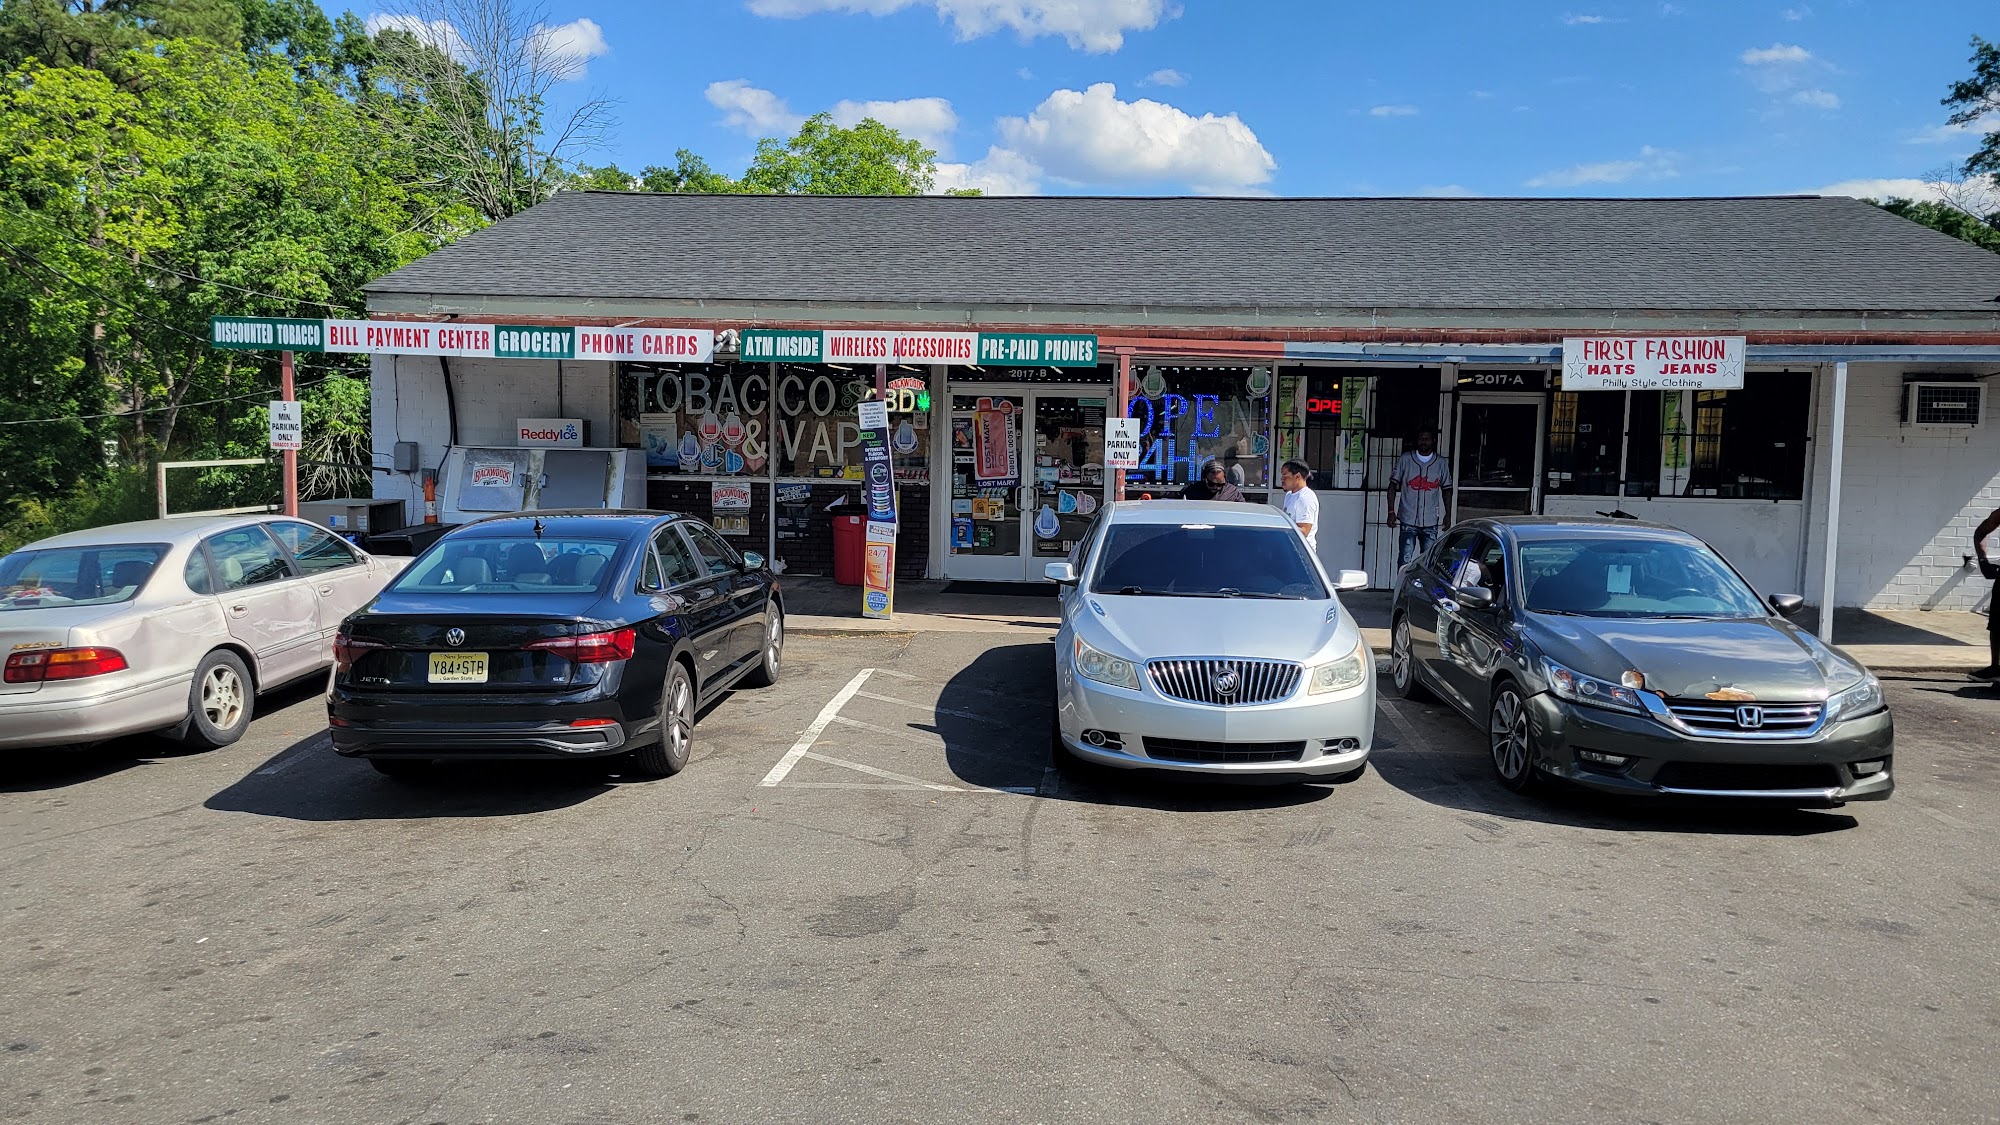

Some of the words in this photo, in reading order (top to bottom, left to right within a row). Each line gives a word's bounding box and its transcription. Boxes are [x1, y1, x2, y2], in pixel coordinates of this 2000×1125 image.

[214, 321, 273, 344] DISCOUNTED
[276, 324, 321, 346] TOBACCO
[330, 326, 359, 346] BILL
[367, 327, 430, 348] PAYMENT
[438, 329, 490, 350] CENTER
[499, 330, 570, 353] GROCERY
[581, 333, 634, 354] PHONE
[642, 334, 698, 356] CARDS
[745, 336, 773, 357] ATM
[776, 336, 819, 357] INSIDE
[830, 337, 887, 357] WIRELESS
[893, 337, 971, 359] ACCESSORIES
[982, 339, 1039, 361] PRE-PAID
[1044, 340, 1093, 362] PHONES
[1583, 340, 1638, 361] FIRST
[1645, 339, 1725, 361] FASHION
[1587, 364, 1636, 375] HATS
[1659, 363, 1718, 375] JEANS
[1602, 378, 1627, 388] Philly
[1631, 379, 1657, 388] Style
[1661, 378, 1703, 389] Clothing
[1307, 398, 1341, 414] OPE
[278, 413, 292, 421] MIN.
[1120, 420, 1125, 428] 5
[271, 423, 299, 431] PARKING
[983, 418, 991, 443] MARY
[1115, 430, 1130, 438] MIN.
[278, 433, 293, 441] ONLY
[521, 428, 578, 442] ReddyIce
[742, 419, 769, 460] &
[779, 420, 862, 464] VAP
[1107, 441, 1137, 449] PARKING
[984, 446, 992, 469] LOST
[1113, 451, 1130, 460] ONLY
[457, 653, 474, 661] Jersey
[360, 676, 390, 684] JETTA
